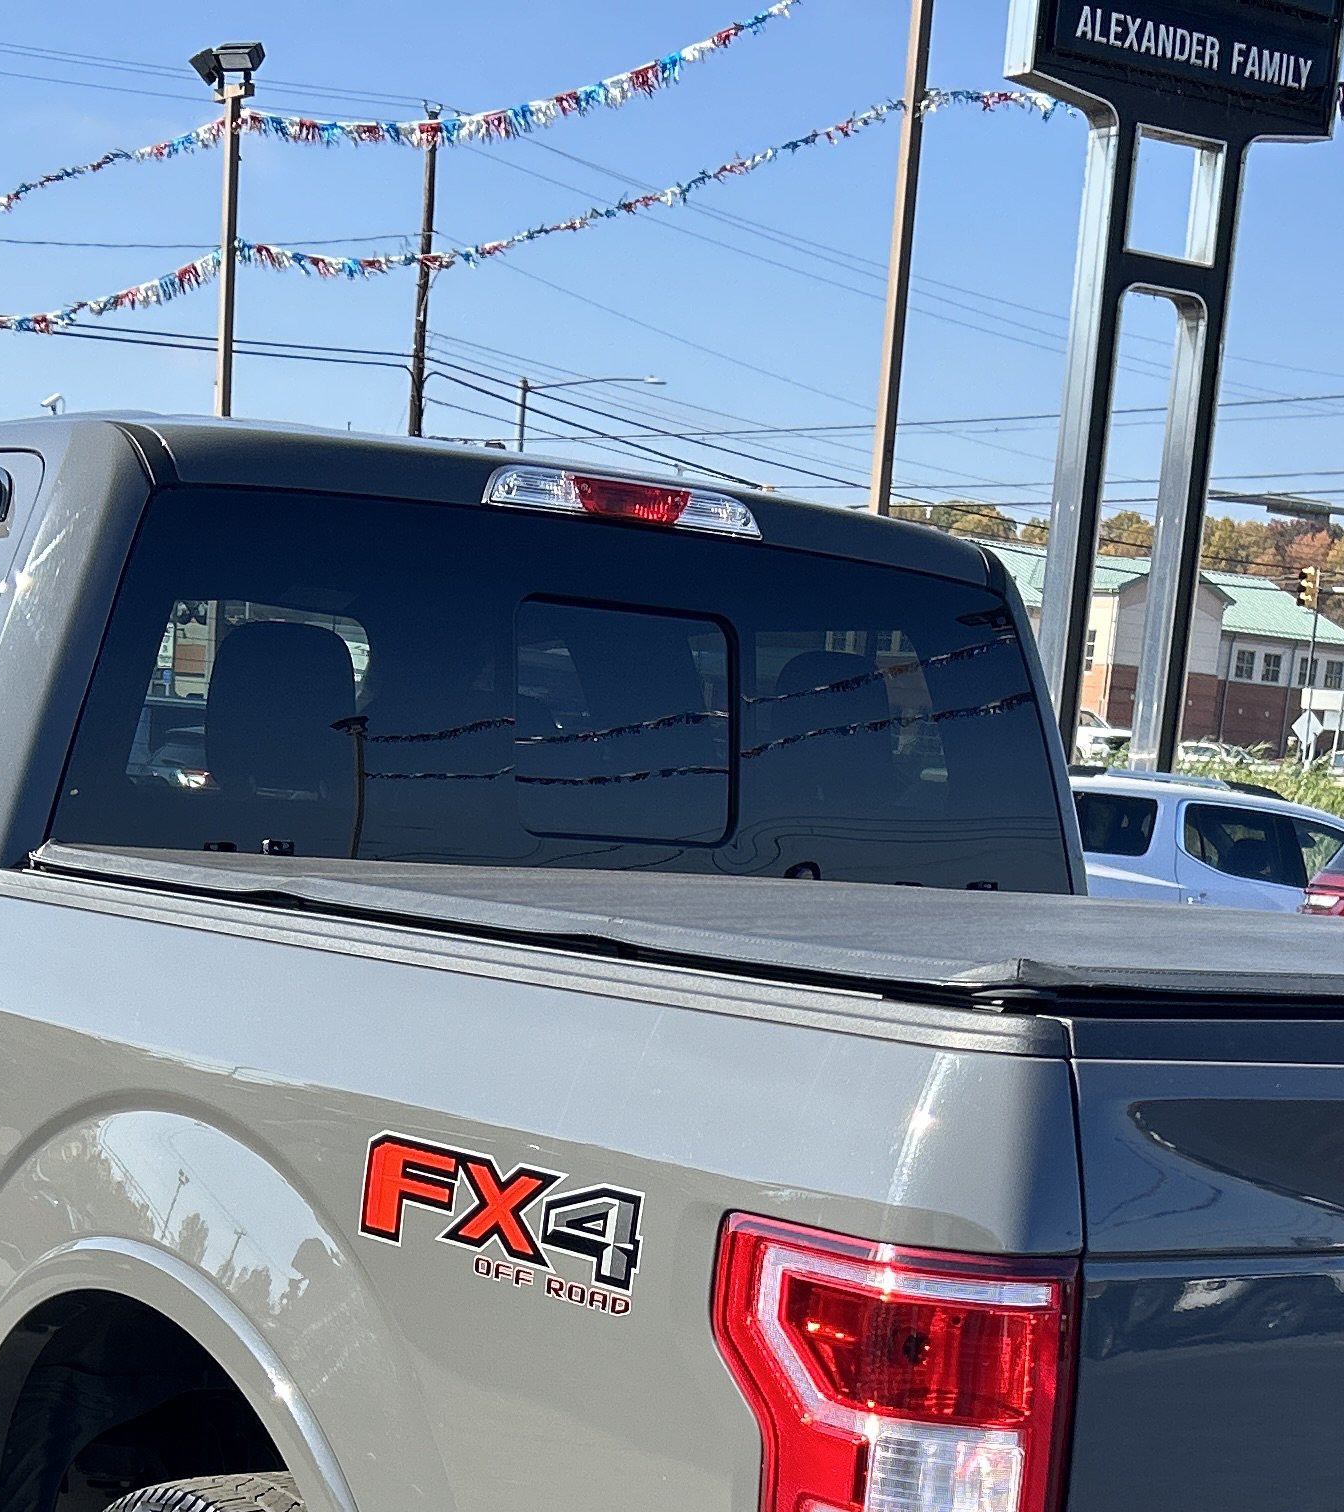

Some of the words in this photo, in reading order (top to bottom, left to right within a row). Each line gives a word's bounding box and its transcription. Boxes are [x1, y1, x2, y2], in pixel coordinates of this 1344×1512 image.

[1075, 5, 1220, 71] ALEXANDER
[1231, 42, 1313, 91] FAMILY
[358, 1130, 646, 1296] FX4
[473, 1254, 535, 1288] OFF
[544, 1274, 633, 1317] ROAD
